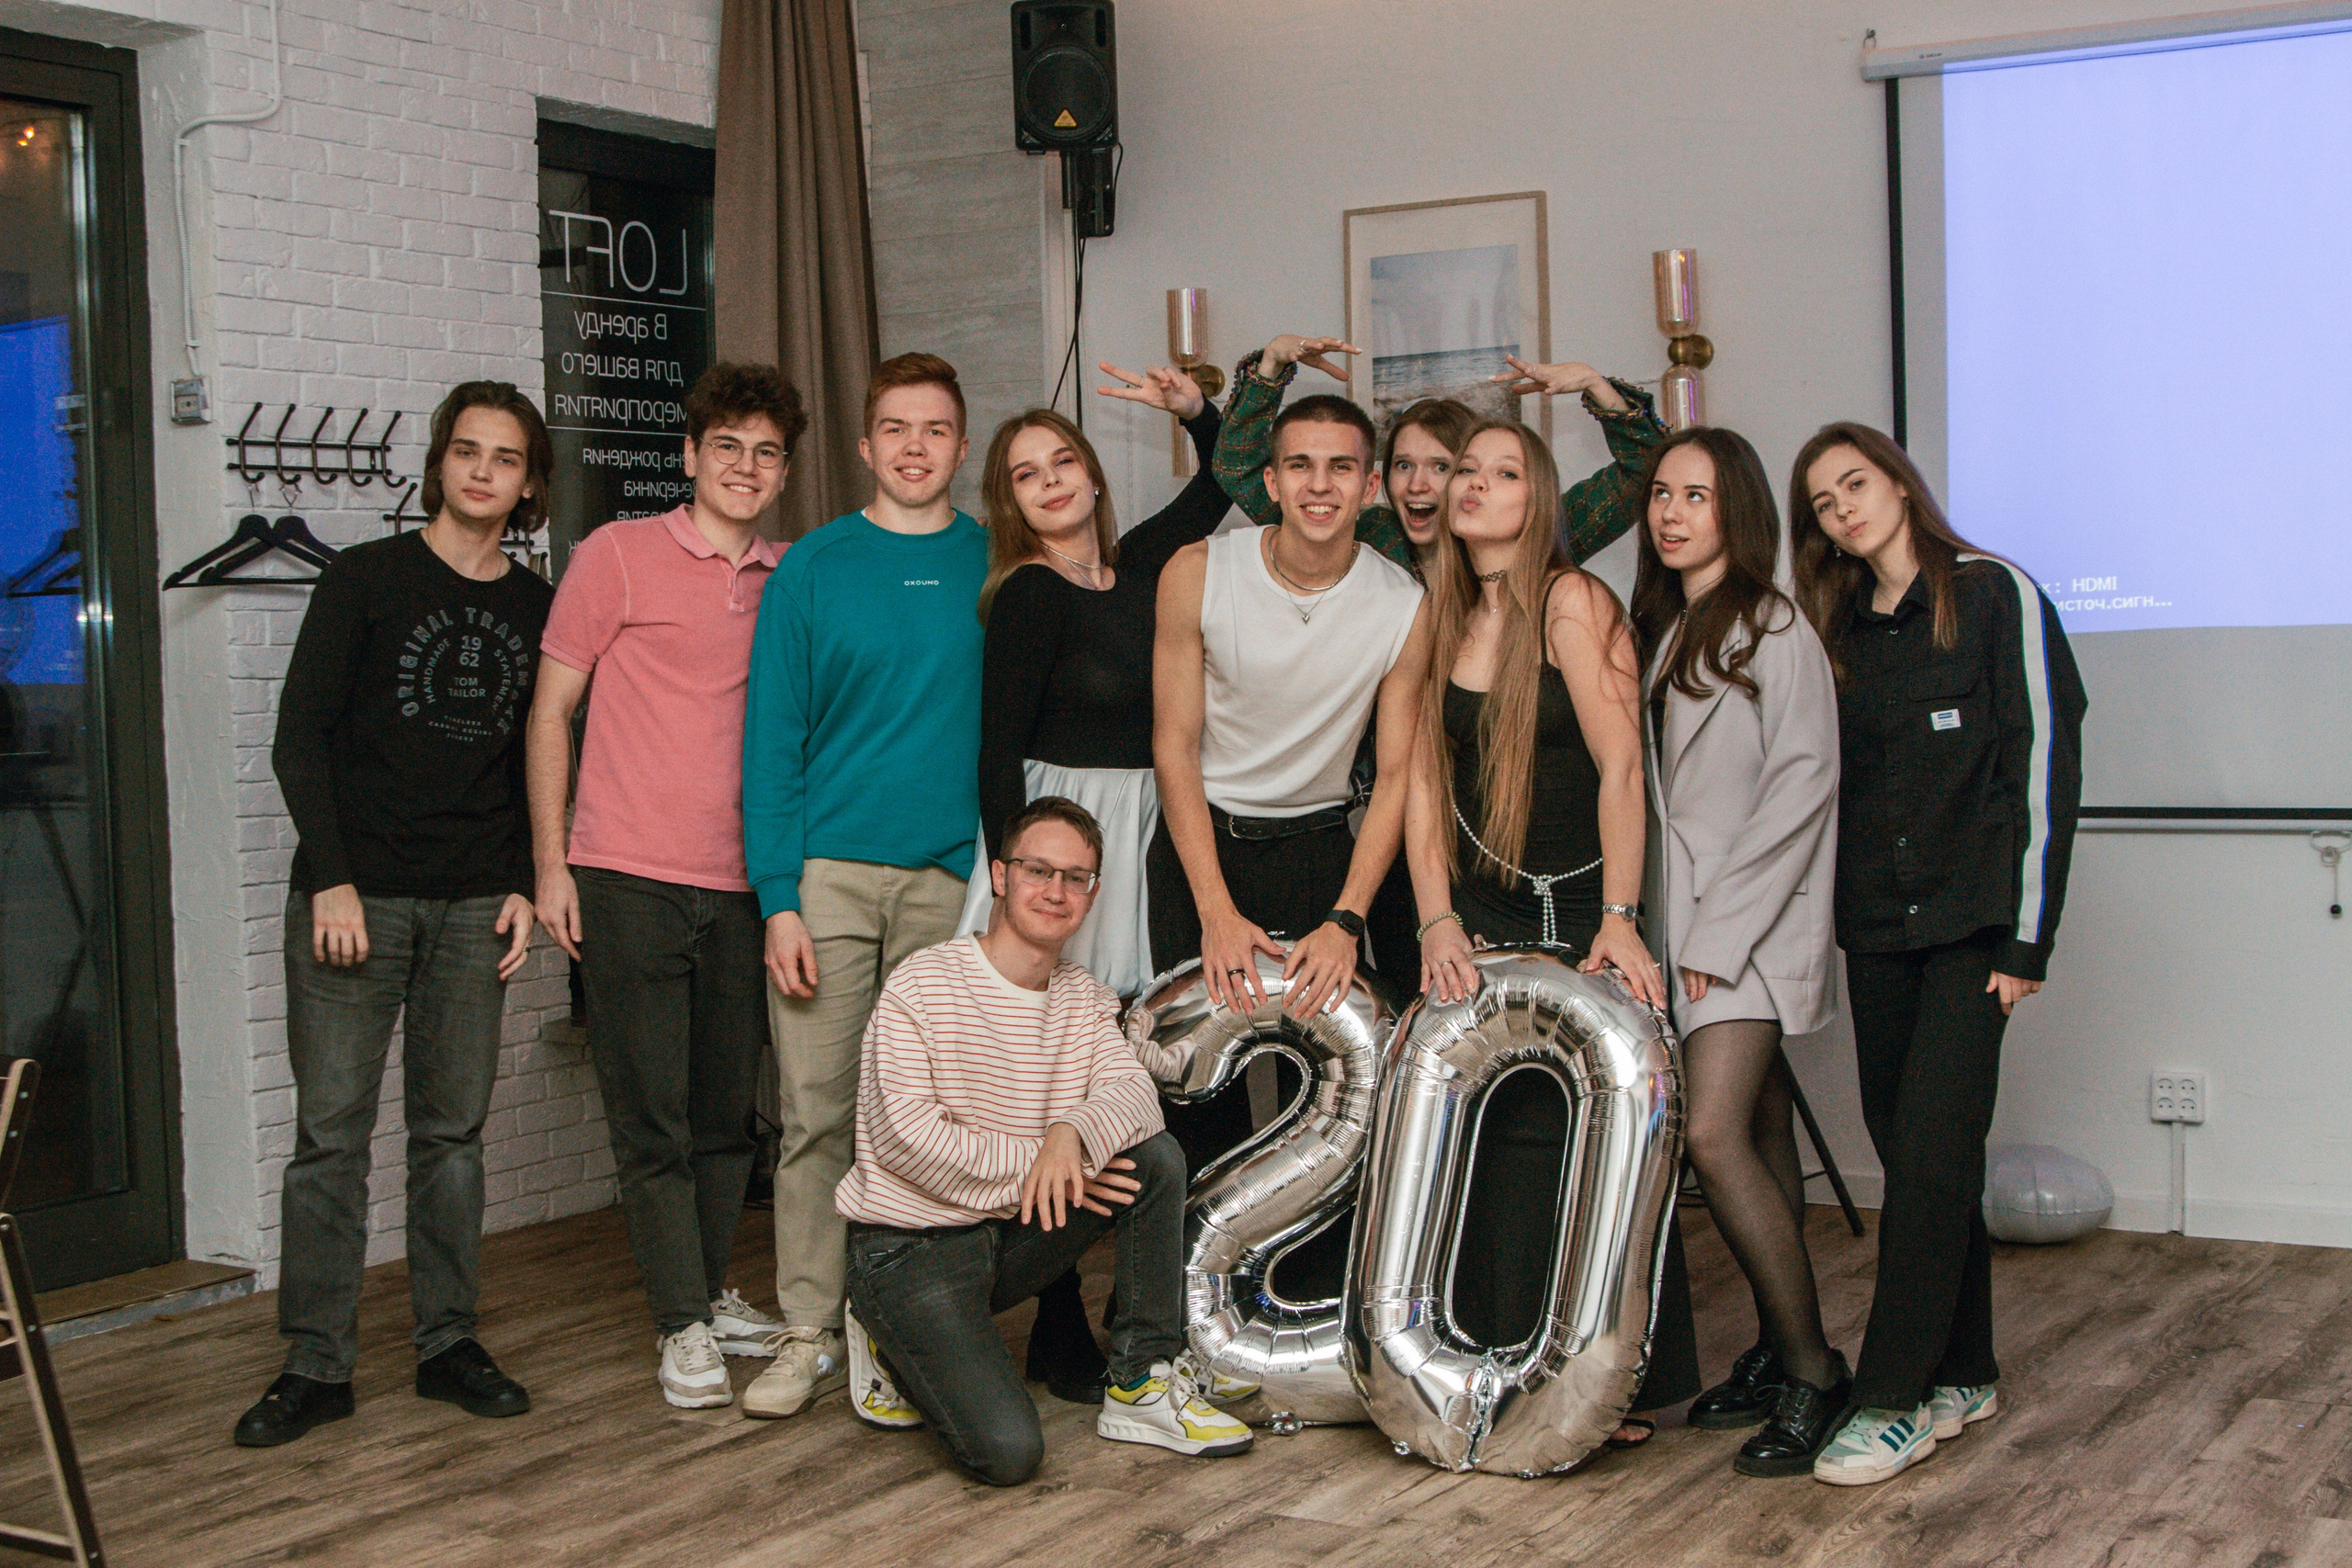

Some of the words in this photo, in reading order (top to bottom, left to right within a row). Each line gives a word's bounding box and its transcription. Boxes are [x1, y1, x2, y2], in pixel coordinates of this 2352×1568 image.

[2072, 576, 2118, 593] HDMI
[461, 636, 482, 651] 19
[398, 610, 454, 716] ORIGINAL
[459, 652, 480, 667] 62
[424, 638, 451, 704] HANDMADE
[454, 677, 479, 686] TOM
[448, 688, 486, 698] TAILOR
